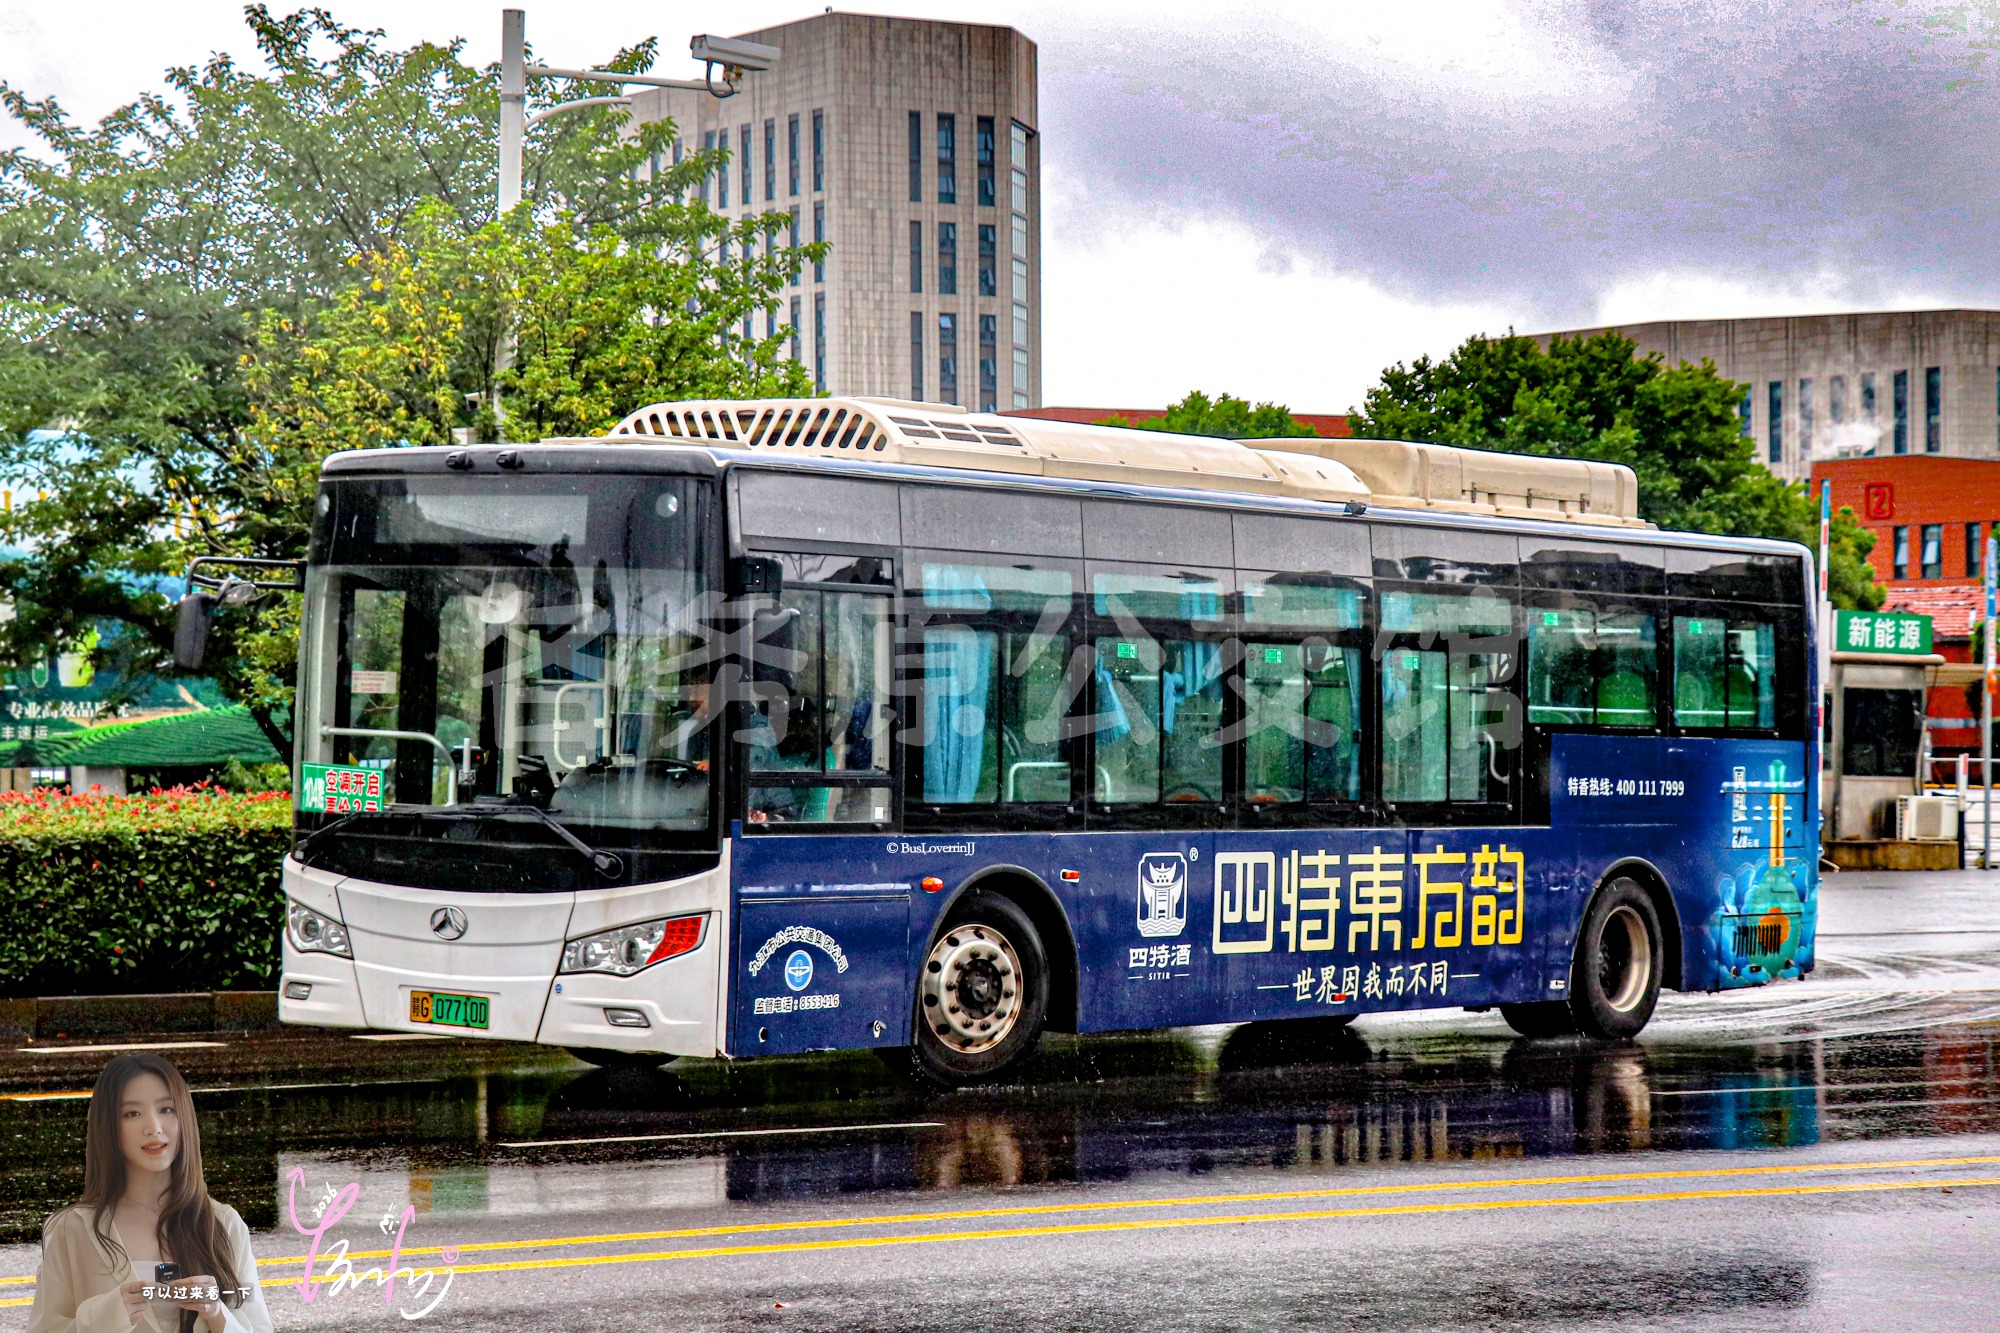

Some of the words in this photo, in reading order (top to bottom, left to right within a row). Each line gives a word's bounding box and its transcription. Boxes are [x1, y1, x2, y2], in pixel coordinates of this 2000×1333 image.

[1872, 487, 1886, 514] 2
[1848, 616, 1921, 649] 新能源
[325, 769, 380, 798] 空调开启
[1616, 779, 1636, 796] 400
[1638, 780, 1657, 796] 111
[1659, 780, 1685, 796] 7999
[748, 925, 849, 977] 九江市公共交通集团公司
[1128, 944, 1192, 968] 四特酒
[1148, 972, 1171, 980] SITIR
[1292, 960, 1449, 1004] 世界因我而不同
